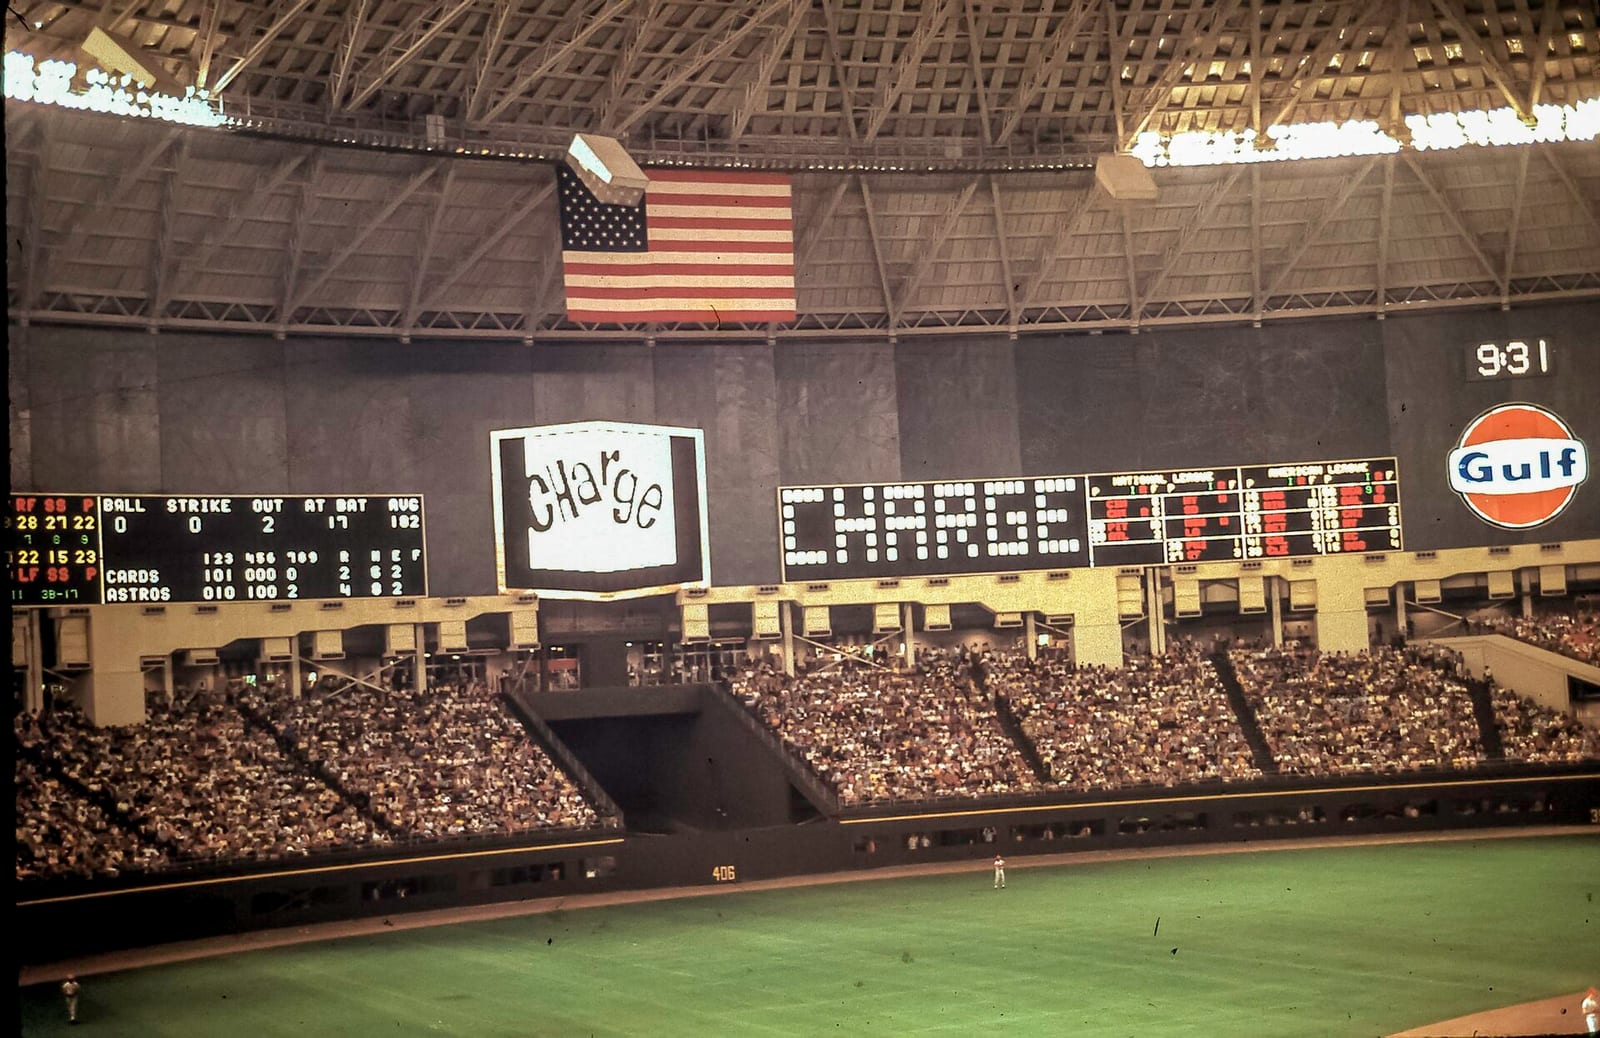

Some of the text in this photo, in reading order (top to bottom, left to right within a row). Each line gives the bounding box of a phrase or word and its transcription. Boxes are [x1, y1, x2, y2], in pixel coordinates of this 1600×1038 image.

[1476, 339, 1548, 377] 9:31
[1458, 447, 1577, 483] Gulf
[16, 498, 94, 512] RF SS P
[103, 498, 419, 512] BALL STRIKE OUT AT BAT AVG
[16, 516, 38, 530] 28
[45, 516, 68, 530] 27
[73, 516, 95, 530] 22
[114, 516, 127, 533] 0
[189, 516, 202, 533] 0
[262, 516, 274, 533] 2
[329, 516, 348, 529] 17
[783, 478, 1080, 565] CHARGE
[24, 534, 32, 544] 7
[80, 534, 88, 544] 9
[18, 550, 96, 564] 22 15 23
[340, 550, 350, 562] R
[370, 550, 380, 562] H
[392, 550, 400, 562] E
[18, 567, 40, 582] LF
[48, 567, 70, 582] SS
[86, 567, 97, 581] P
[106, 569, 160, 584] CARDS
[286, 567, 298, 581] 0
[339, 566, 350, 580] 2
[391, 564, 402, 578] 2
[106, 586, 170, 602] ASTROS
[287, 584, 298, 598] 2
[340, 583, 351, 596] 4
[392, 582, 402, 595] 2
[712, 865, 736, 881] 406
